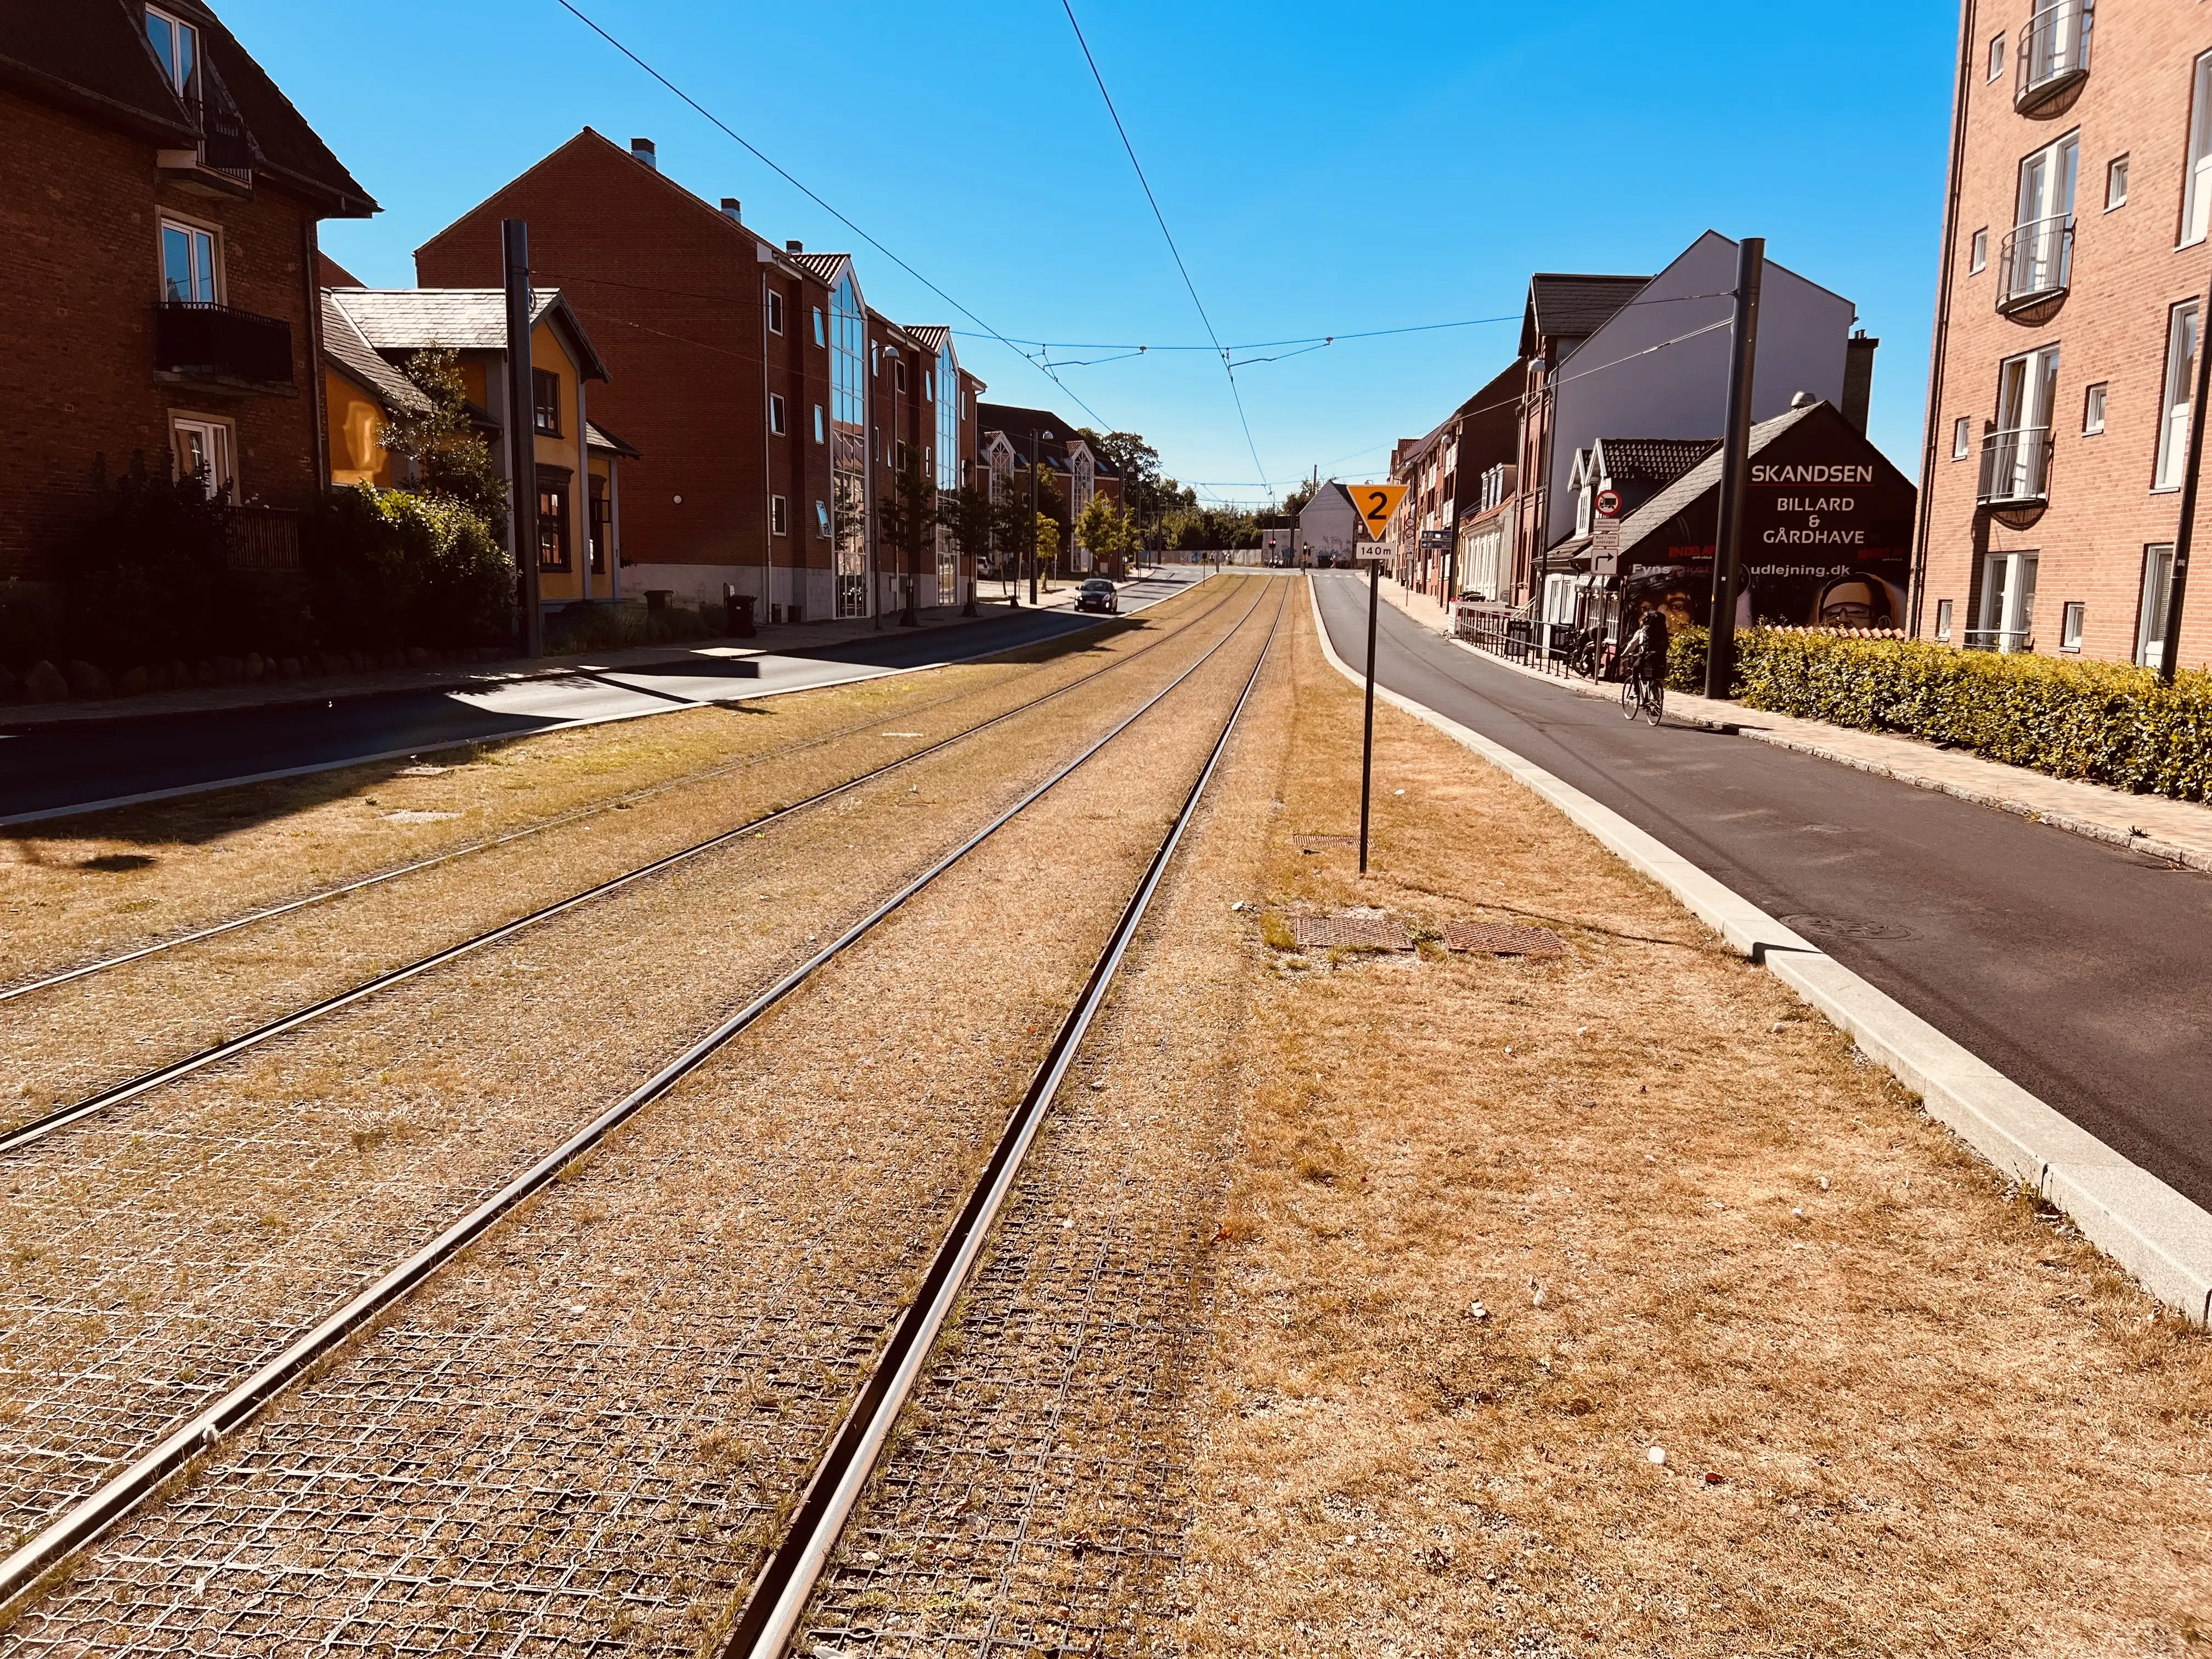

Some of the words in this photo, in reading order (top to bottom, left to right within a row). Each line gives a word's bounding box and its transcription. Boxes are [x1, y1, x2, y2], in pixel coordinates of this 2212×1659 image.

[1751, 465, 1873, 482] SKANDSEN
[1367, 492, 1387, 520] 2
[1777, 498, 1855, 511] BILLARD
[1808, 515, 1820, 527] &
[1763, 527, 1865, 544] GÅRDHAVE
[1632, 564, 1671, 575] Fyns
[1750, 565, 1850, 577] udlejning.dk
